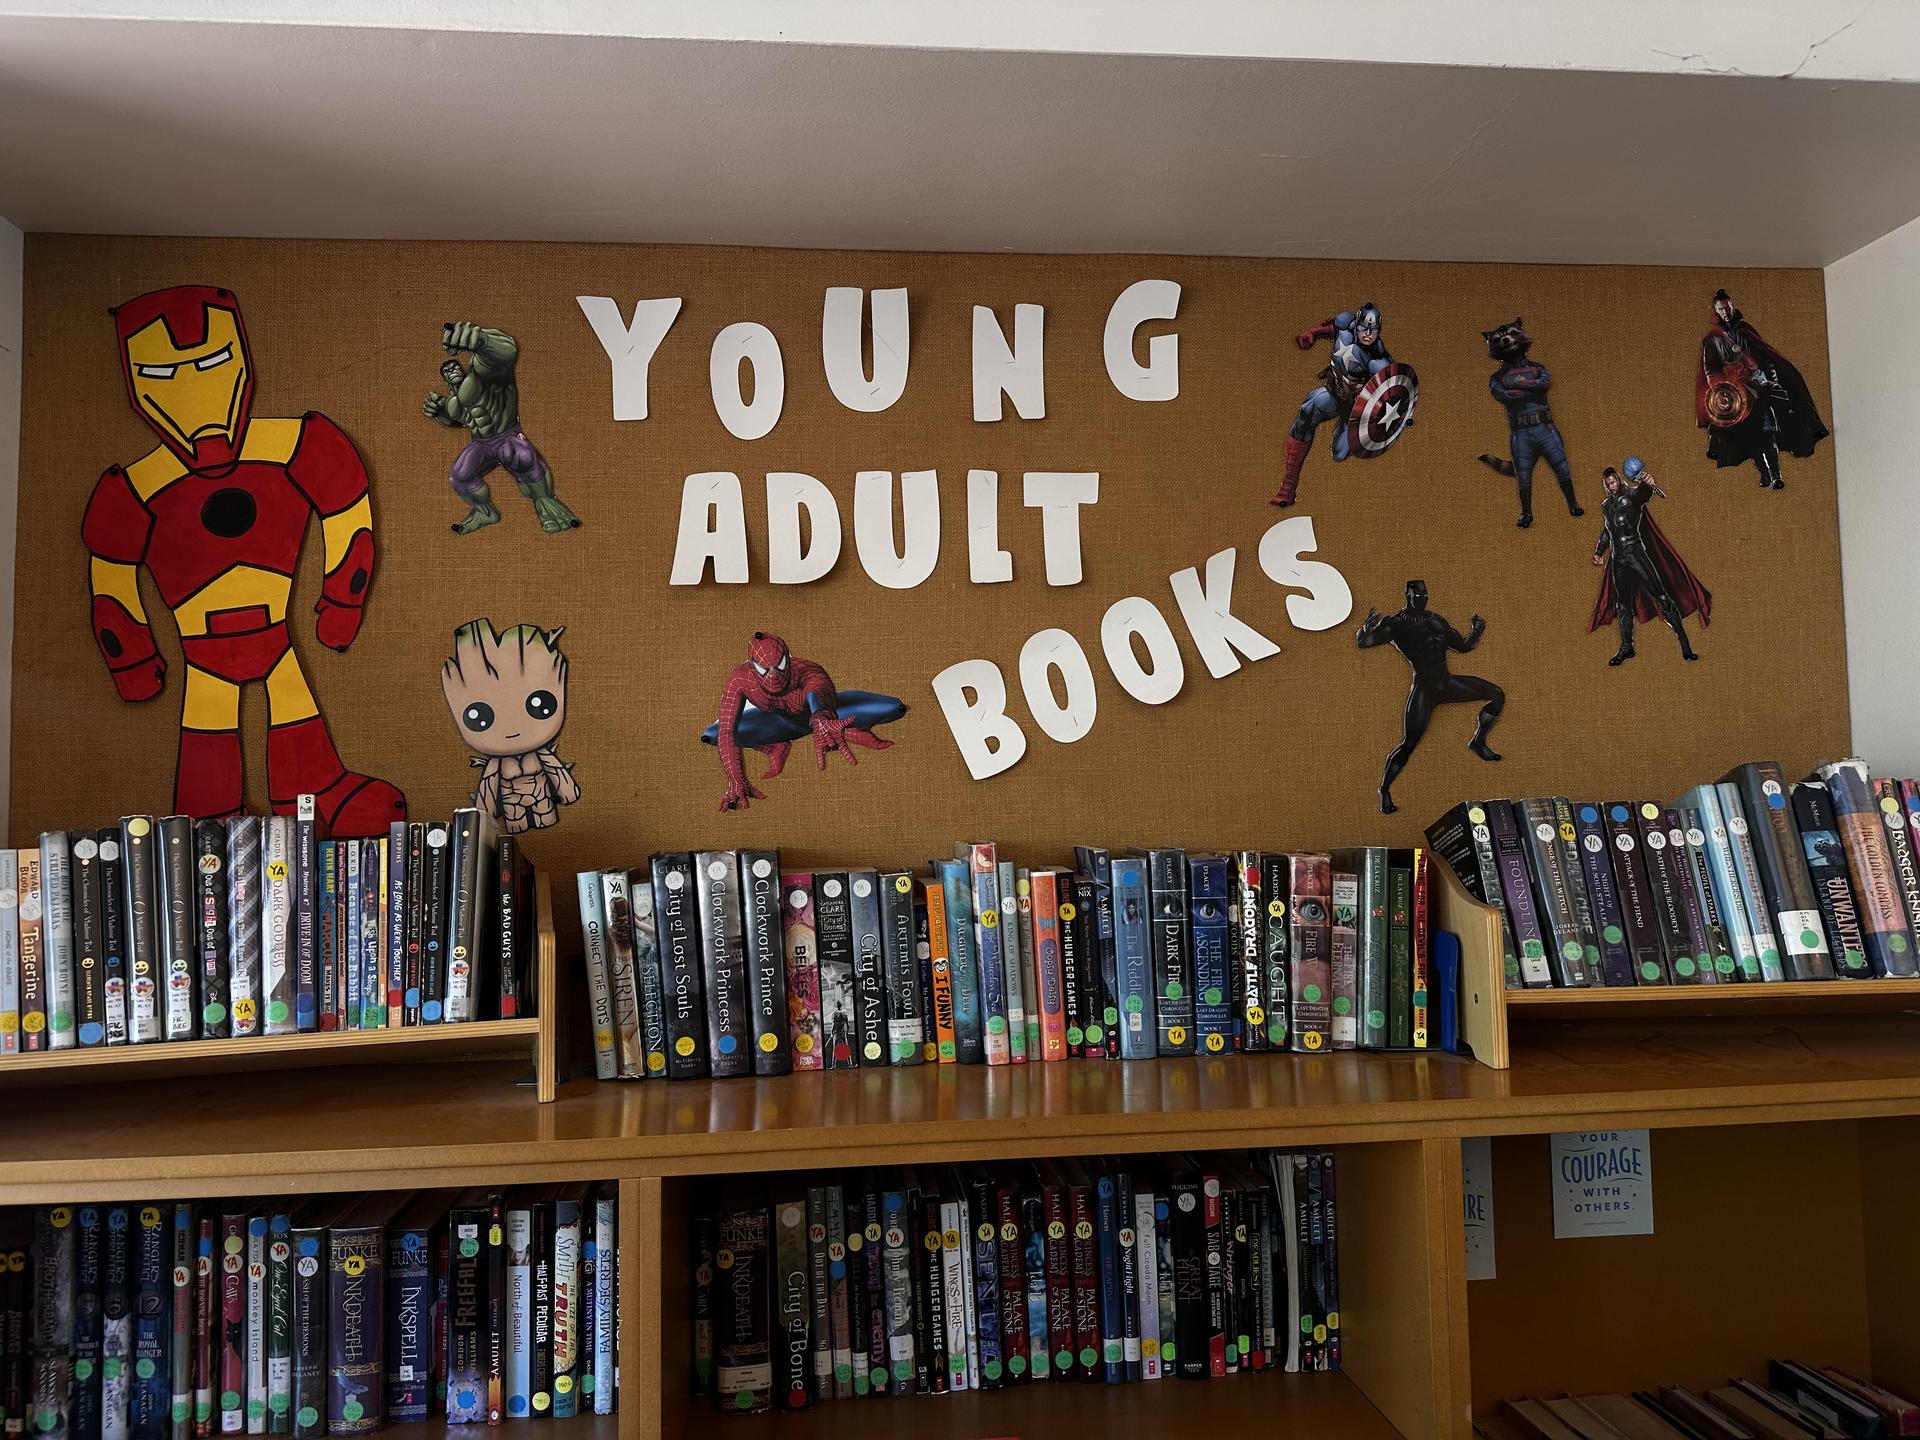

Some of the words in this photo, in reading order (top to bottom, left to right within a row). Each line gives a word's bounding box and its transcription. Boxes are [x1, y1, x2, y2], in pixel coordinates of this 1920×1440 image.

[576, 279, 1181, 441] YOUNG
[669, 469, 1100, 589] ADULT
[931, 516, 1353, 780] BOOKS
[1809, 800, 1821, 826] McMann
[1586, 837, 1600, 849] YA
[1616, 837, 1632, 847] YA
[1861, 826, 1874, 842] THE
[50, 853, 58, 889] STRIPED
[270, 865, 285, 876] YA
[325, 847, 334, 871] KEVIN
[1590, 855, 1598, 871] THE
[1865, 845, 1883, 878] GOLDEN
[20, 866, 30, 894] BLOOR
[29, 860, 39, 899] EDWARD
[326, 873, 334, 894] HART
[610, 881, 622, 894] YA
[1592, 873, 1601, 892] SOUL
[51, 891, 60, 930] PAJAMAS
[349, 882, 358, 926] Because
[502, 894, 511, 905] the
[1100, 895, 1109, 935] AMULET
[1596, 893, 1608, 927] STEALER
[1816, 878, 1831, 910] ISLAND
[1826, 914, 1835, 925] OF
[1876, 882, 1893, 920] COMPASS
[299, 912, 312, 947] DRIVE-IN
[349, 929, 358, 939] of
[502, 908, 511, 928] BAD
[670, 920, 685, 932] of
[755, 880, 770, 962] Clockwork
[983, 912, 996, 925] YA
[1007, 921, 1015, 943] KING
[1245, 889, 1257, 956] DRAGONS
[301, 949, 311, 957] OF
[349, 943, 358, 962] the
[502, 931, 511, 958] GUYS
[587, 921, 603, 966] CONNECT
[672, 936, 688, 972] Lost
[710, 881, 725, 963] Clockwork
[718, 969, 732, 1032] Princess
[857, 933, 877, 972] City
[897, 914, 909, 974] ARTEMIS
[956, 918, 968, 970] DAUGHTER
[1008, 945, 1016, 954] OF
[1064, 936, 1075, 979] HUNGER
[1126, 935, 1138, 952] The
[1165, 924, 1180, 960] DARK
[1305, 930, 1317, 953] FIRE
[1344, 946, 1353, 961] THE
[22, 927, 39, 1000] Tangerine
[301, 960, 312, 984] DOOM
[795, 945, 807, 998] BELLES
[1009, 959, 1018, 997] SHADOWS
[1167, 965, 1181, 984] FIR
[1196, 931, 1210, 1001] ASCENDING
[1268, 914, 1285, 1021] CAUGHT
[1333, 942, 1343, 988] ETERNAL
[1345, 964, 1354, 986] FIRE
[349, 965, 359, 1001] Rabbit
[594, 972, 604, 991] THE
[612, 963, 634, 1027] SIREN
[674, 974, 693, 1019] Souls
[761, 967, 775, 1015] Prince
[862, 977, 878, 992] of
[1067, 982, 1077, 1015] GAMES
[1247, 961, 1258, 1008] BATTLE
[596, 998, 609, 1025] DOTS
[641, 967, 662, 1052] SELECTION
[902, 980, 914, 1019] FOWL
[937, 987, 952, 1029] FUNNY
[864, 995, 880, 1041] Ashe
[1209, 1038, 1221, 1046] YA
[1579, 1133, 1618, 1142] YOUR
[1562, 1147, 1642, 1183] COURAGE
[1076, 1194, 1084, 1222] HALE
[1584, 1187, 1620, 1197] WITH
[1102, 1205, 1110, 1231] Hansen
[1299, 1201, 1307, 1244] AMULET
[1312, 1200, 1320, 1241] AMULET
[1326, 1200, 1335, 1241] AMULET
[151, 1222, 161, 1283] RANGER'S
[331, 1245, 378, 1259] FUNKE
[391, 1251, 427, 1264] FUNKE
[556, 1236, 576, 1280] SMITH
[1123, 1247, 1133, 1270] Night
[1143, 1234, 1151, 1249] Full
[814, 1252, 825, 1268] OUT
[815, 1270, 825, 1279] OF
[891, 1247, 903, 1281] Johnny
[1144, 1251, 1152, 1279] Cicada
[1223, 1240, 1234, 1295] Wringer
[225, 1275, 240, 1304] CLAWS
[513, 1275, 522, 1300] North
[600, 1249, 611, 1307] SECRETS
[784, 1271, 806, 1314] City
[929, 1265, 941, 1313] HUNGER
[978, 1241, 994, 1329] SENT
[1003, 1289, 1012, 1300] OF
[1051, 1287, 1059, 1298] OF
[1077, 1287, 1085, 1298] OF
[1125, 1271, 1133, 1295] Flight
[1145, 1283, 1153, 1305] Moon
[1176, 1258, 1190, 1303] HUNT
[512, 1302, 523, 1310] of
[732, 1255, 753, 1343] INKDEATH
[817, 1297, 827, 1319] DARK
[893, 1285, 906, 1327] Tremain
[1013, 1290, 1023, 1333] PALACE
[1051, 1299, 1061, 1333] STONE
[1061, 1288, 1071, 1330] PALACE
[1087, 1288, 1096, 1331] PALACE
[274, 1315, 287, 1336] Cat
[398, 1286, 422, 1365] INKSPELL
[513, 1312, 523, 1353] Beautiful
[555, 1283, 568, 1358] TRUTH
[570, 1324, 576, 1335] OF
[586, 1322, 592, 1331] IN
[600, 1310, 610, 1353] FAMILY
[788, 1318, 806, 1334] of
[932, 1315, 942, 1351] GAMES
[1003, 1302, 1014, 1335] STONE
[1077, 1300, 1086, 1333] STONE
[491, 1331, 499, 1376] AMULET
[871, 1309, 884, 1364] enemy
[790, 1339, 807, 1390] Bone
